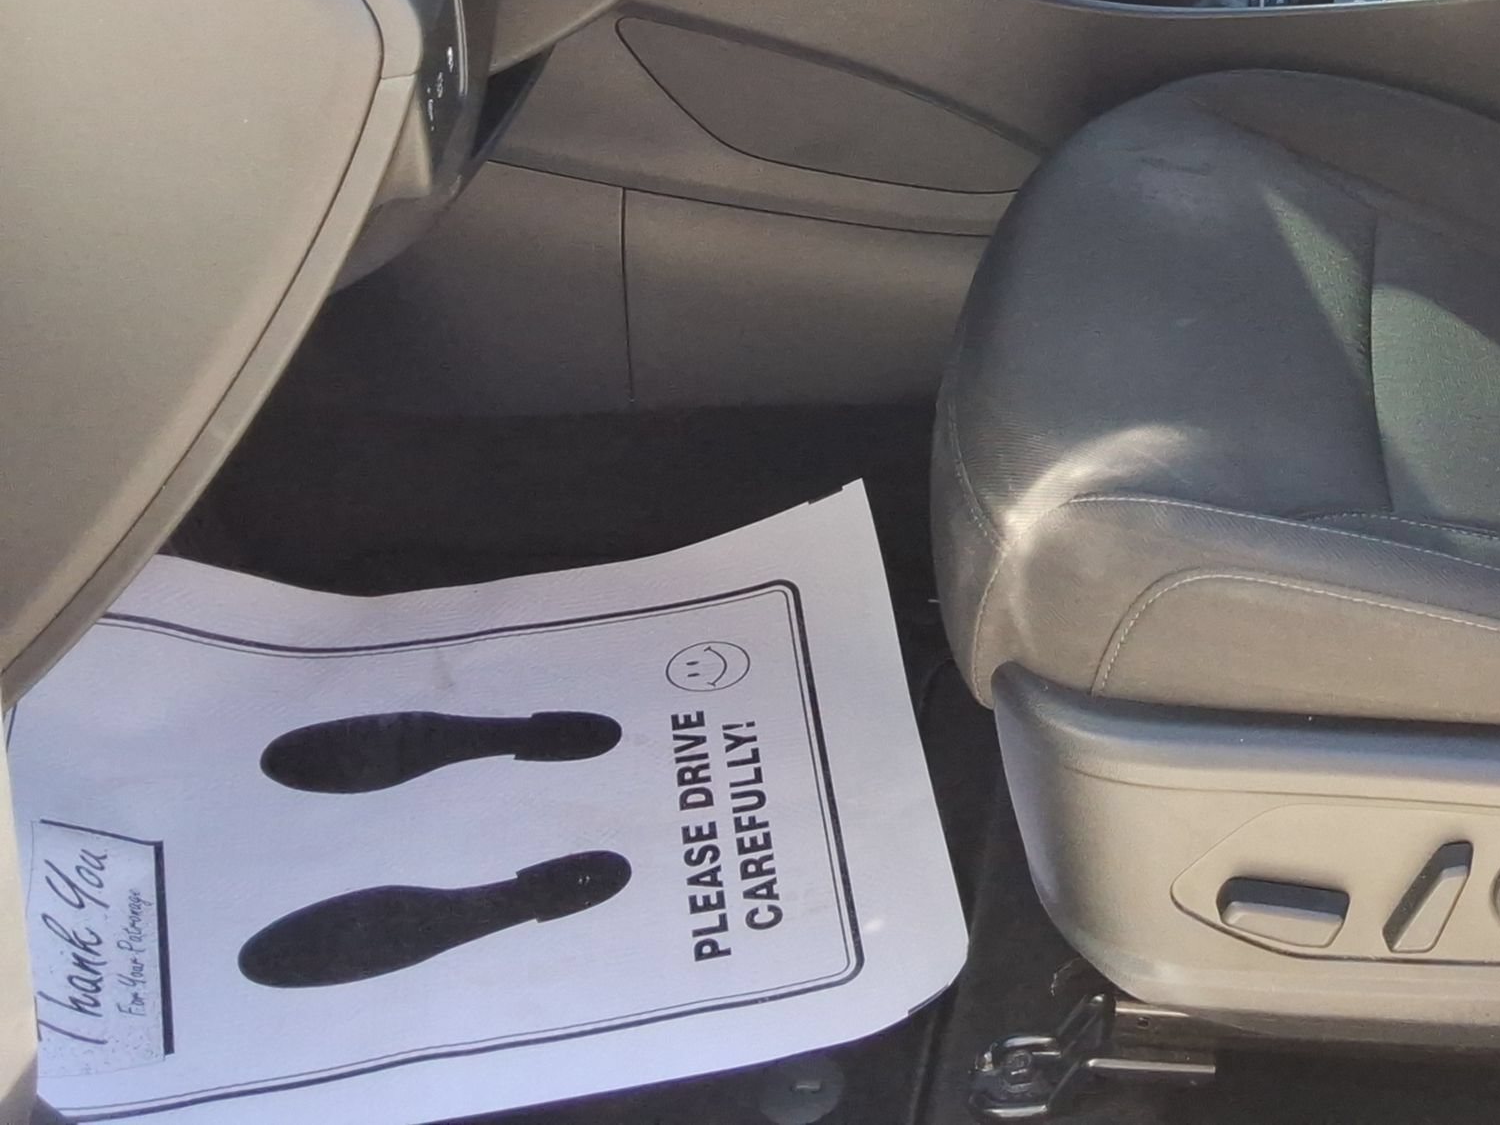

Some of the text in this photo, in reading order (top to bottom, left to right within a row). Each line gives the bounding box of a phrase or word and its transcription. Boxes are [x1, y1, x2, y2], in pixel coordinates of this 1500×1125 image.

[671, 710, 732, 962] PLEASE DRIVE
[722, 720, 784, 931] CAREFULLY!
[34, 848, 109, 1045] Thank You
[117, 889, 153, 1016] For Your Patronage
